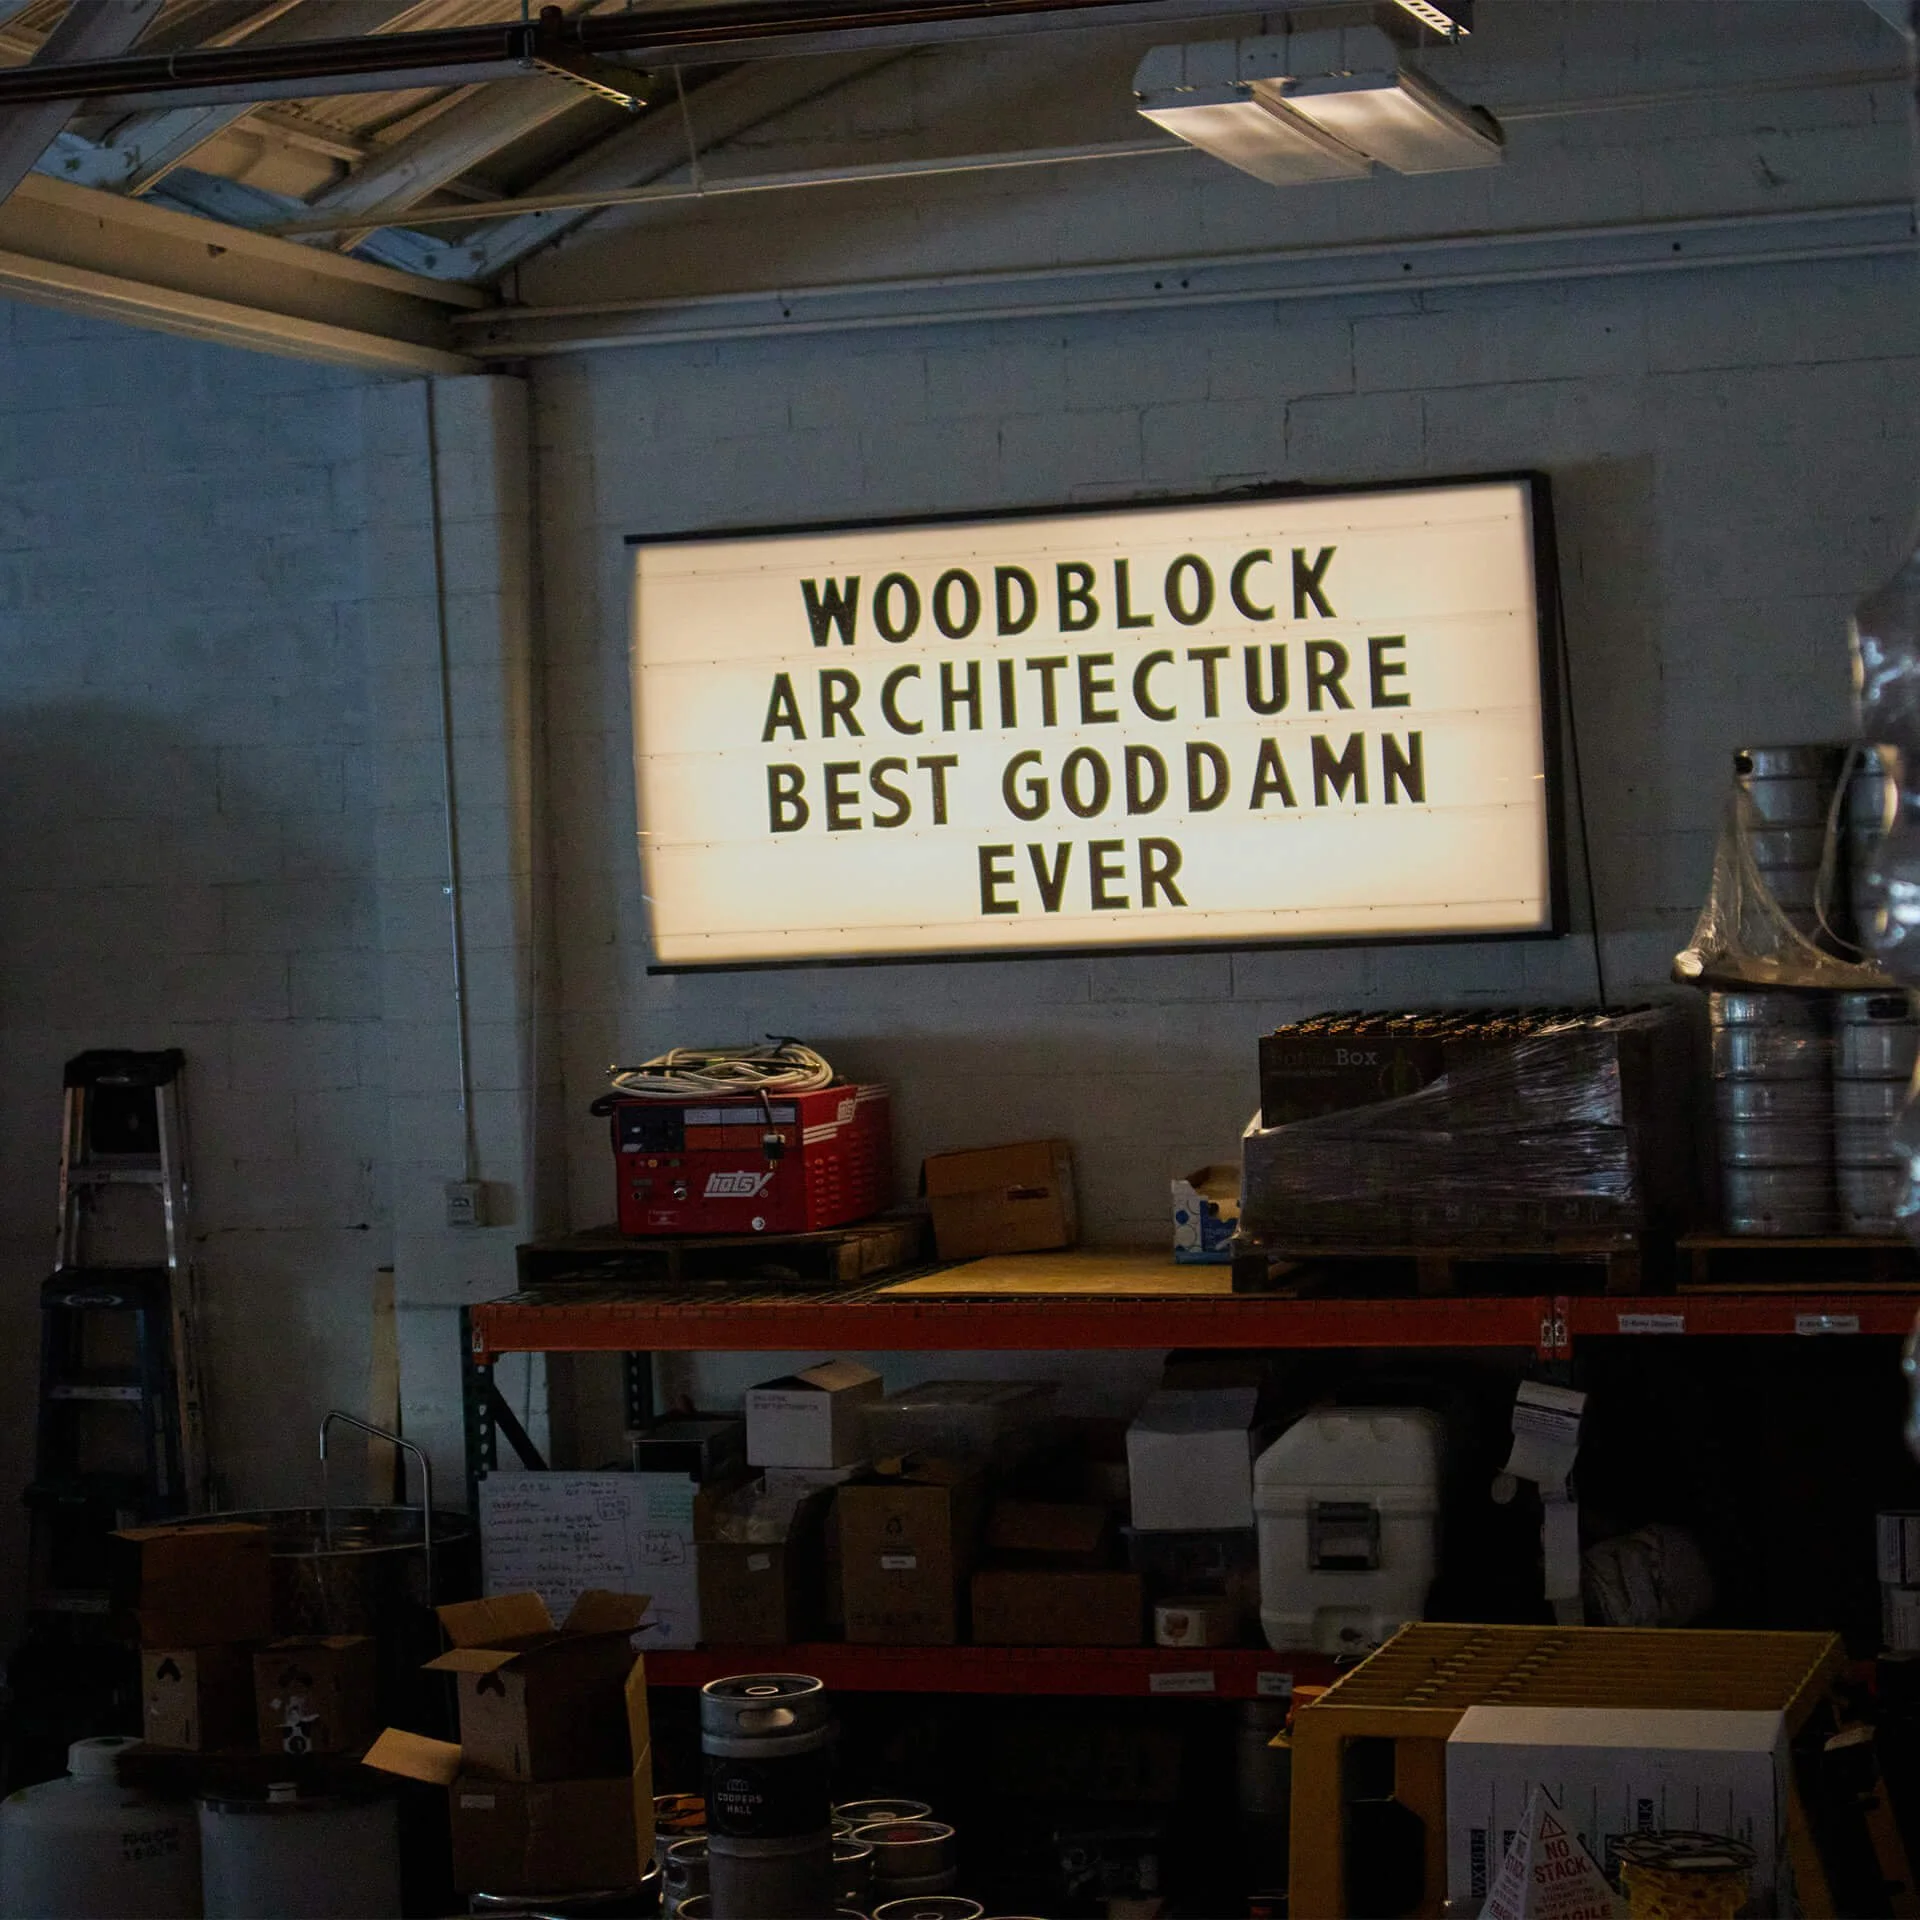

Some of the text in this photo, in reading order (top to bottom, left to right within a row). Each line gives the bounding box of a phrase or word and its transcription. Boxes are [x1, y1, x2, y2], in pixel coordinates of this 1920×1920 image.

[800, 547, 1336, 647] WOODBLOCK
[762, 636, 1410, 742] ARCHITECTURE
[768, 732, 1425, 832] BEST GODDAMN
[979, 838, 1187, 915] EVER
[1335, 1048, 1378, 1066] Box
[1534, 1856, 1588, 1884] STACK
[1544, 1838, 1570, 1861] NO
